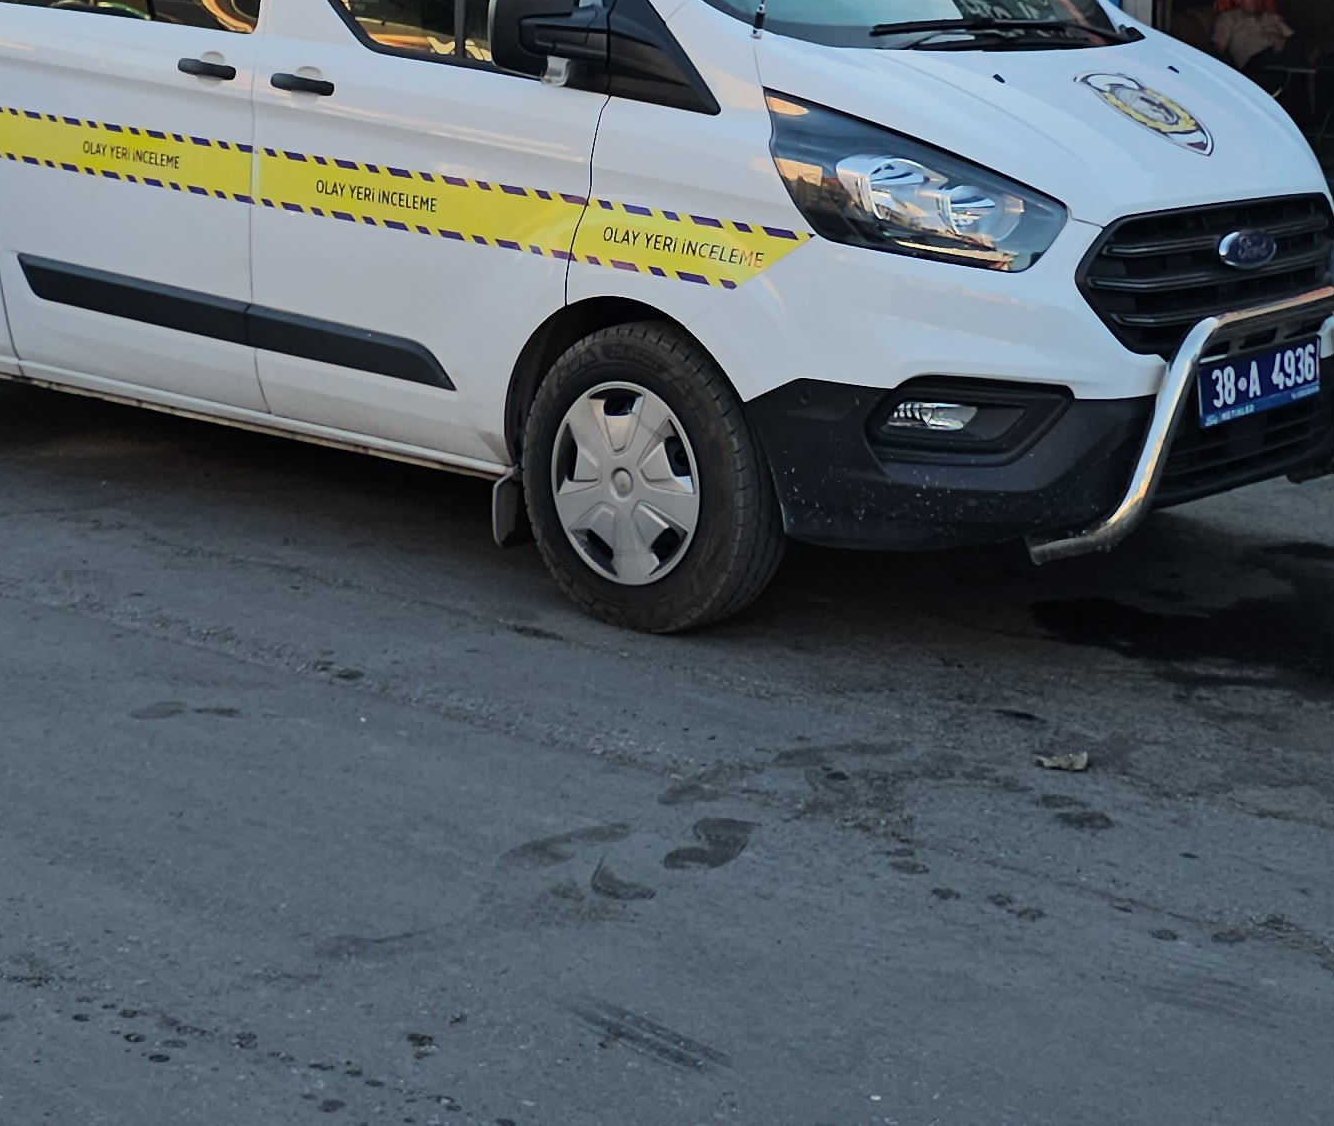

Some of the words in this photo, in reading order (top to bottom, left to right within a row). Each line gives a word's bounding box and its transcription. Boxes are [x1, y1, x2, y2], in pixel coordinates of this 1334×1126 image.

[82, 140, 107, 157] OLAY
[316, 179, 346, 199] OLAY
[602, 226, 641, 248] OLAY
[1271, 343, 1315, 390] 4936
